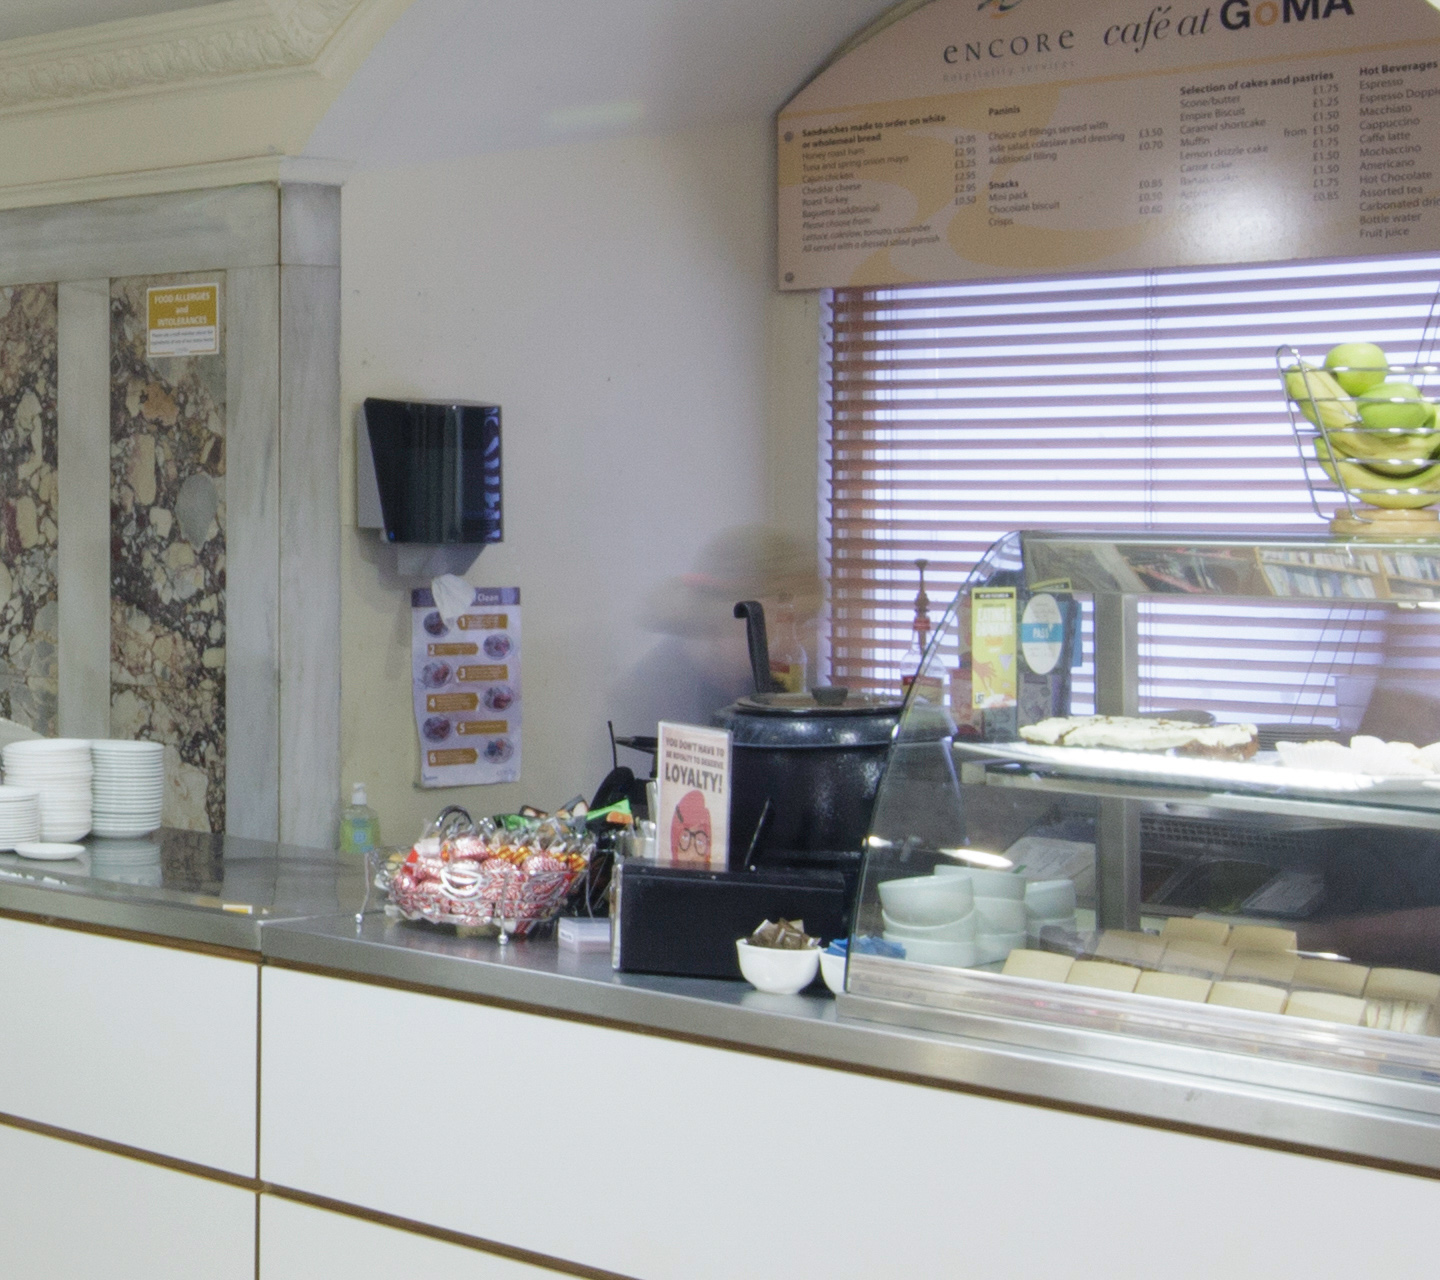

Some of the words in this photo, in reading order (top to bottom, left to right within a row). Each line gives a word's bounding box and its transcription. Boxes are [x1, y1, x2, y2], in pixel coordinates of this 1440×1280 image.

[1104, 6, 1171, 53] café
[1178, 8, 1210, 35] at
[1360, 67, 1378, 76] Hot
[1382, 61, 1438, 74] Beverages
[1180, 84, 1225, 95] Selection
[1228, 81, 1238, 89] of
[1240, 79, 1268, 88] cakes
[1271, 76, 1290, 84] and
[1293, 72, 1333, 84] pastries
[1313, 84, 1339, 94] £1.75
[1360, 79, 1403, 90] Espresso
[1313, 97, 1339, 107] £1.25
[1360, 92, 1403, 103] Espresso
[989, 106, 1020, 115] Paninis
[1180, 111, 1212, 121] Empire
[1215, 108, 1245, 118] Biscuit
[1360, 104, 1412, 116] Macchiato
[1313, 111, 1339, 121] £1.50
[802, 126, 848, 137] Sandwiches
[851, 123, 872, 131] made
[885, 120, 907, 128] order
[922, 115, 946, 123] white
[1180, 123, 1218, 135] Caramel
[1220, 118, 1266, 130] shortcake
[1360, 118, 1420, 130] Cappuccino
[989, 131, 1016, 141] Choice
[1059, 124, 1087, 133] served
[1089, 122, 1108, 130] with
[1139, 128, 1163, 138] £3.50
[1284, 128, 1307, 137] from
[1313, 124, 1339, 135] £1.50
[812, 136, 855, 147] wholemeal
[858, 134, 881, 142] bread
[1180, 136, 1210, 147] Muffin
[1387, 132, 1410, 141] latte
[989, 144, 1005, 153] side
[1070, 136, 1086, 144] and
[1088, 133, 1125, 142] dressing
[1139, 141, 1163, 150] £0.70
[1313, 138, 1339, 148] £1.75
[1180, 150, 1212, 160] Lemon
[1214, 147, 1244, 156] drizzle
[1247, 145, 1268, 153] cake
[1313, 151, 1339, 160] £1.50
[1360, 144, 1421, 158] Mochaccino
[989, 155, 1032, 165] Additional
[1360, 159, 1415, 171] Americano
[1313, 164, 1339, 174] £1.50
[1360, 174, 1378, 184] Hot
[1381, 170, 1432, 182] Chocolate
[989, 180, 1019, 189] Snacks
[989, 193, 1006, 201] Mini
[1009, 191, 1028, 200] pack
[1360, 186, 1404, 198] Assorted
[1407, 187, 1422, 195] tea
[989, 204, 1030, 213] Chocolate
[1032, 202, 1060, 210] biscuit
[1360, 197, 1420, 211] Carbonated
[1360, 215, 1389, 225] Bottle
[1392, 213, 1421, 223] water
[1360, 228, 1382, 238] Fruit
[1385, 228, 1409, 238] juice
[155, 295, 174, 304] FOOD
[175, 292, 210, 301] ALLERGIES
[176, 305, 189, 314] and
[157, 316, 207, 326] INTOLERANCES
[478, 593, 498, 602] Clean
[460, 669, 465, 677] 3
[429, 699, 435, 707] 4
[460, 725, 465, 733] 5
[666, 738, 677, 747] YOU
[679, 740, 696, 751] DON'T
[699, 744, 714, 755] HAVE
[716, 747, 724, 757] TO
[430, 753, 436, 762] 6
[694, 756, 700, 764] TO
[666, 762, 722, 793] LOYALTY!
